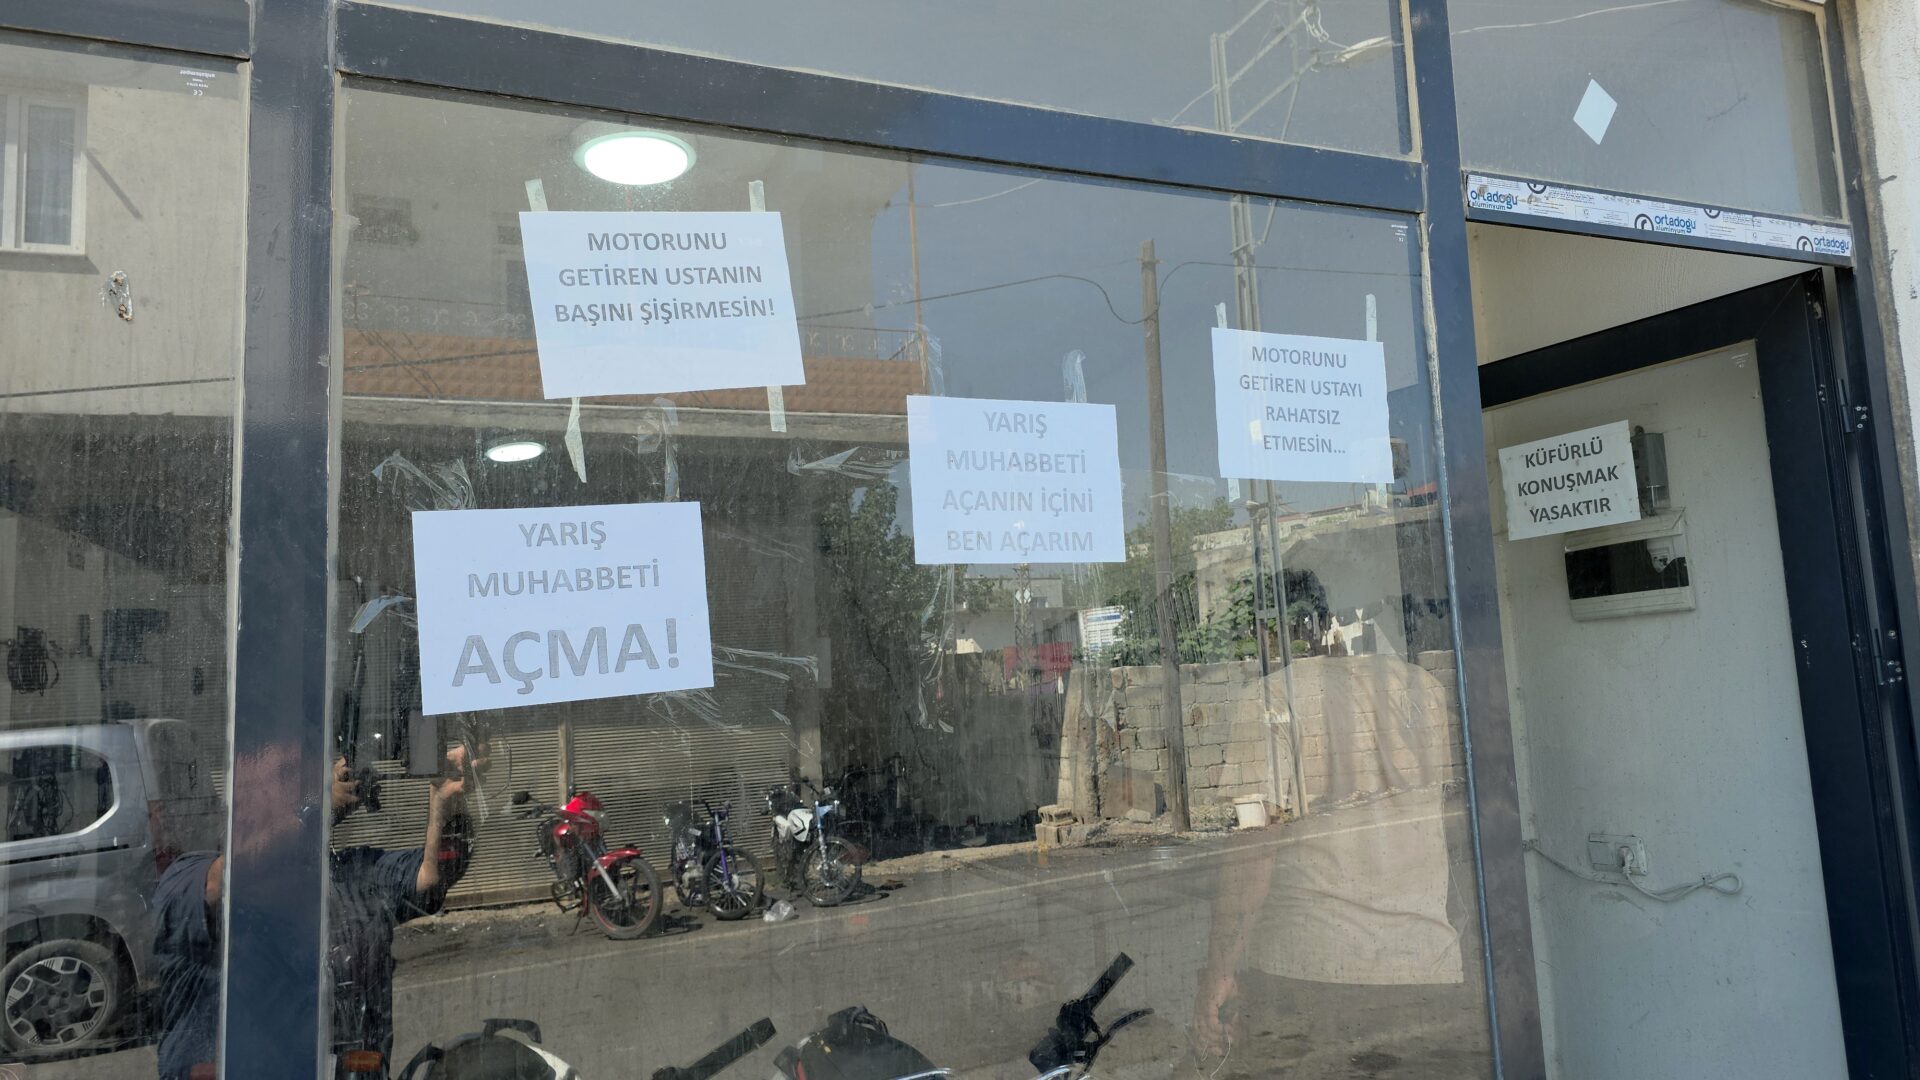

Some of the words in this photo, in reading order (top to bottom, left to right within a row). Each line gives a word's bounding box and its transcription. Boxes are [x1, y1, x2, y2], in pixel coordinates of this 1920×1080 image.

[587, 232, 727, 252] MOTORUNU
[558, 264, 658, 287] GETİREN
[665, 265, 763, 286] USTANIN
[554, 302, 633, 326] BAŞINI
[640, 296, 776, 326] ŞİŞİRMESİN!
[1252, 346, 1346, 369] MOTORUNU
[1239, 373, 1306, 394] GETİREN
[1311, 380, 1363, 397] USTAYI
[984, 411, 1047, 438] YARIŞ
[1266, 406, 1341, 425] RAHATSIZ
[1263, 434, 1346, 454] ETMESİN...
[1524, 436, 1603, 469] KÜFÜRLÜ
[946, 449, 1086, 474] MUHABBETİ
[1518, 464, 1620, 497] KONUŞMAK
[942, 488, 1033, 516] AÇANIN
[1041, 486, 1094, 518] İÇİNİ
[1529, 497, 1612, 524] YASAKTIR
[518, 520, 607, 550] YARIŞ
[946, 530, 992, 552] BEN
[1000, 530, 1094, 556] AÇARIM
[468, 558, 660, 598] MUHABBETİ
[452, 617, 680, 695] AÇMA!
